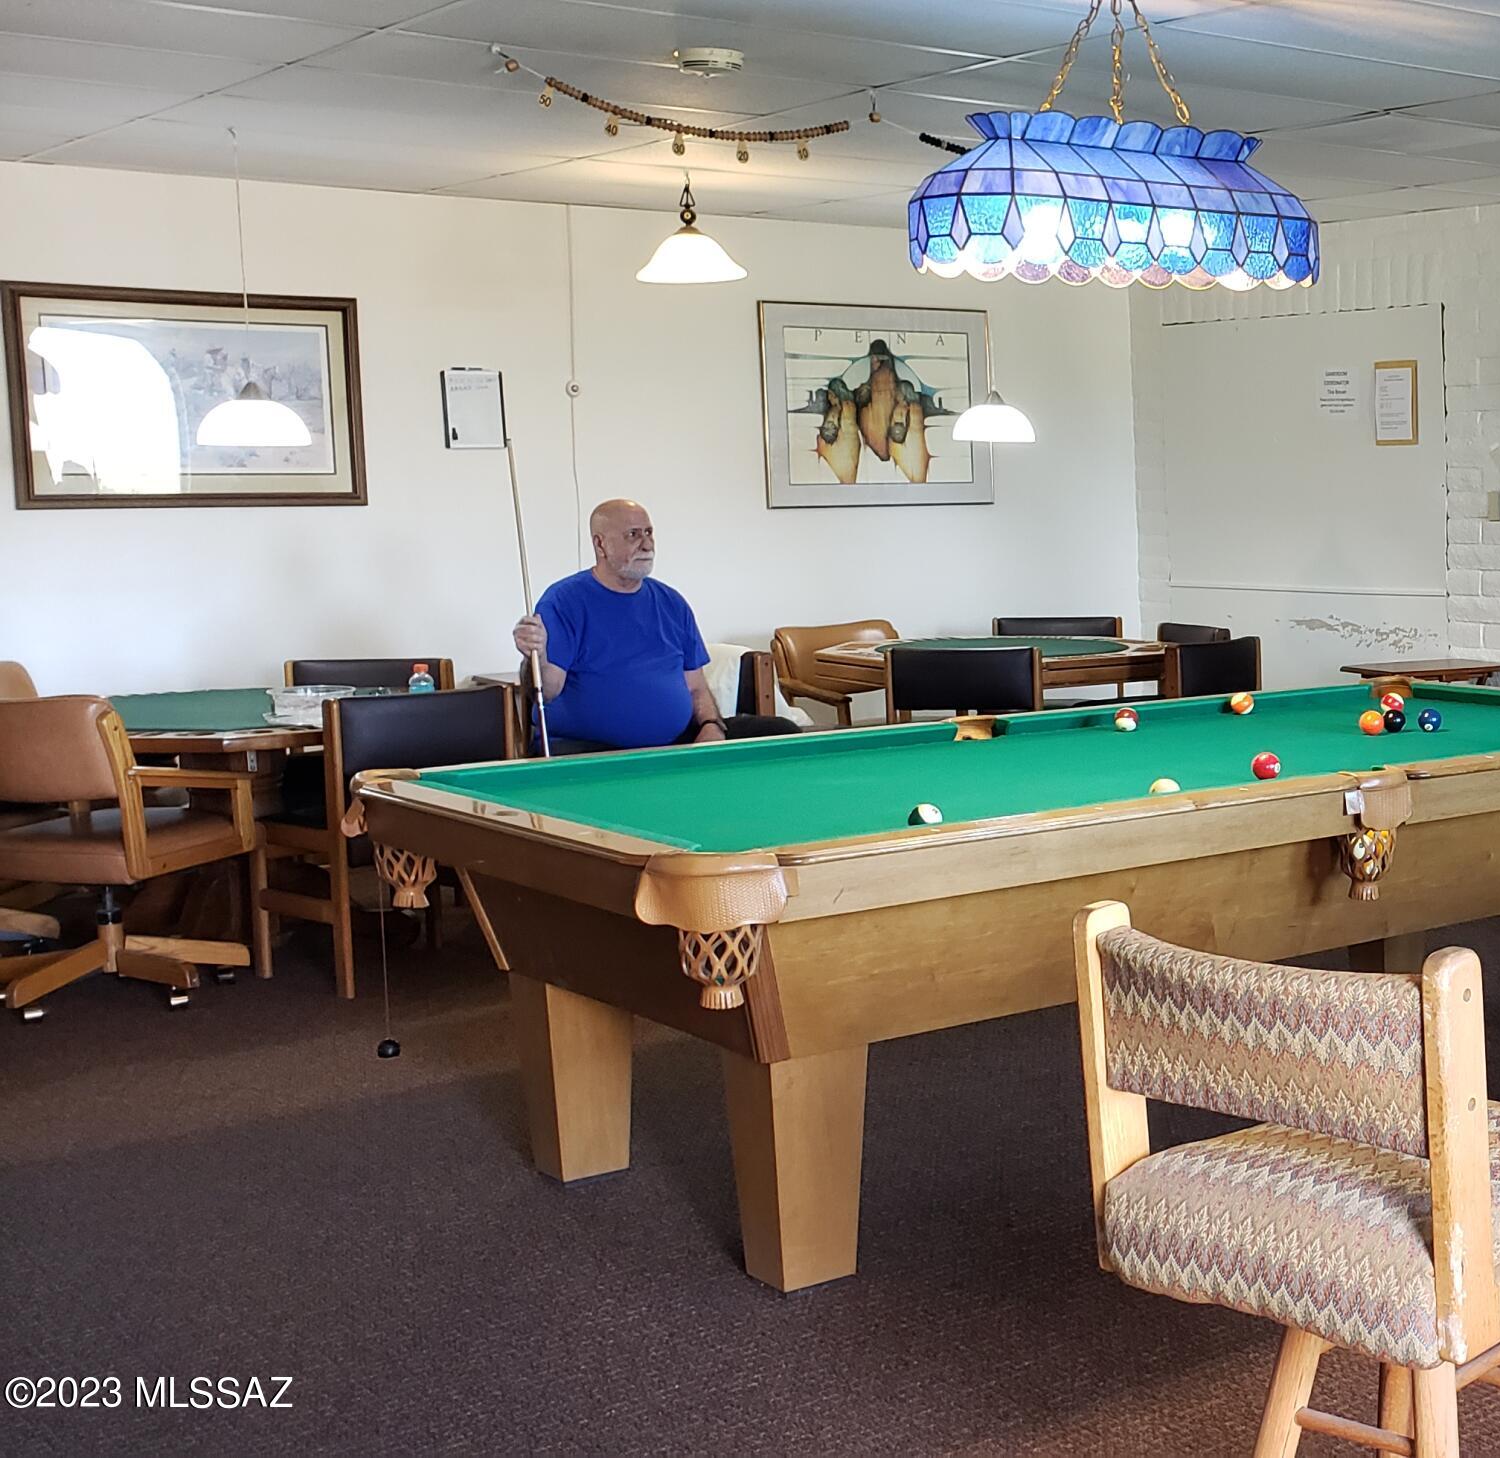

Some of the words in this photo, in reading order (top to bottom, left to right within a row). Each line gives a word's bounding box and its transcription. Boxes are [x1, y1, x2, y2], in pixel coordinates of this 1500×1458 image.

[538, 94, 552, 108] 50
[604, 124, 618, 137] 40
[672, 142, 686, 156] 30
[797, 148, 809, 160] 10
[736, 150, 749, 163] 20
